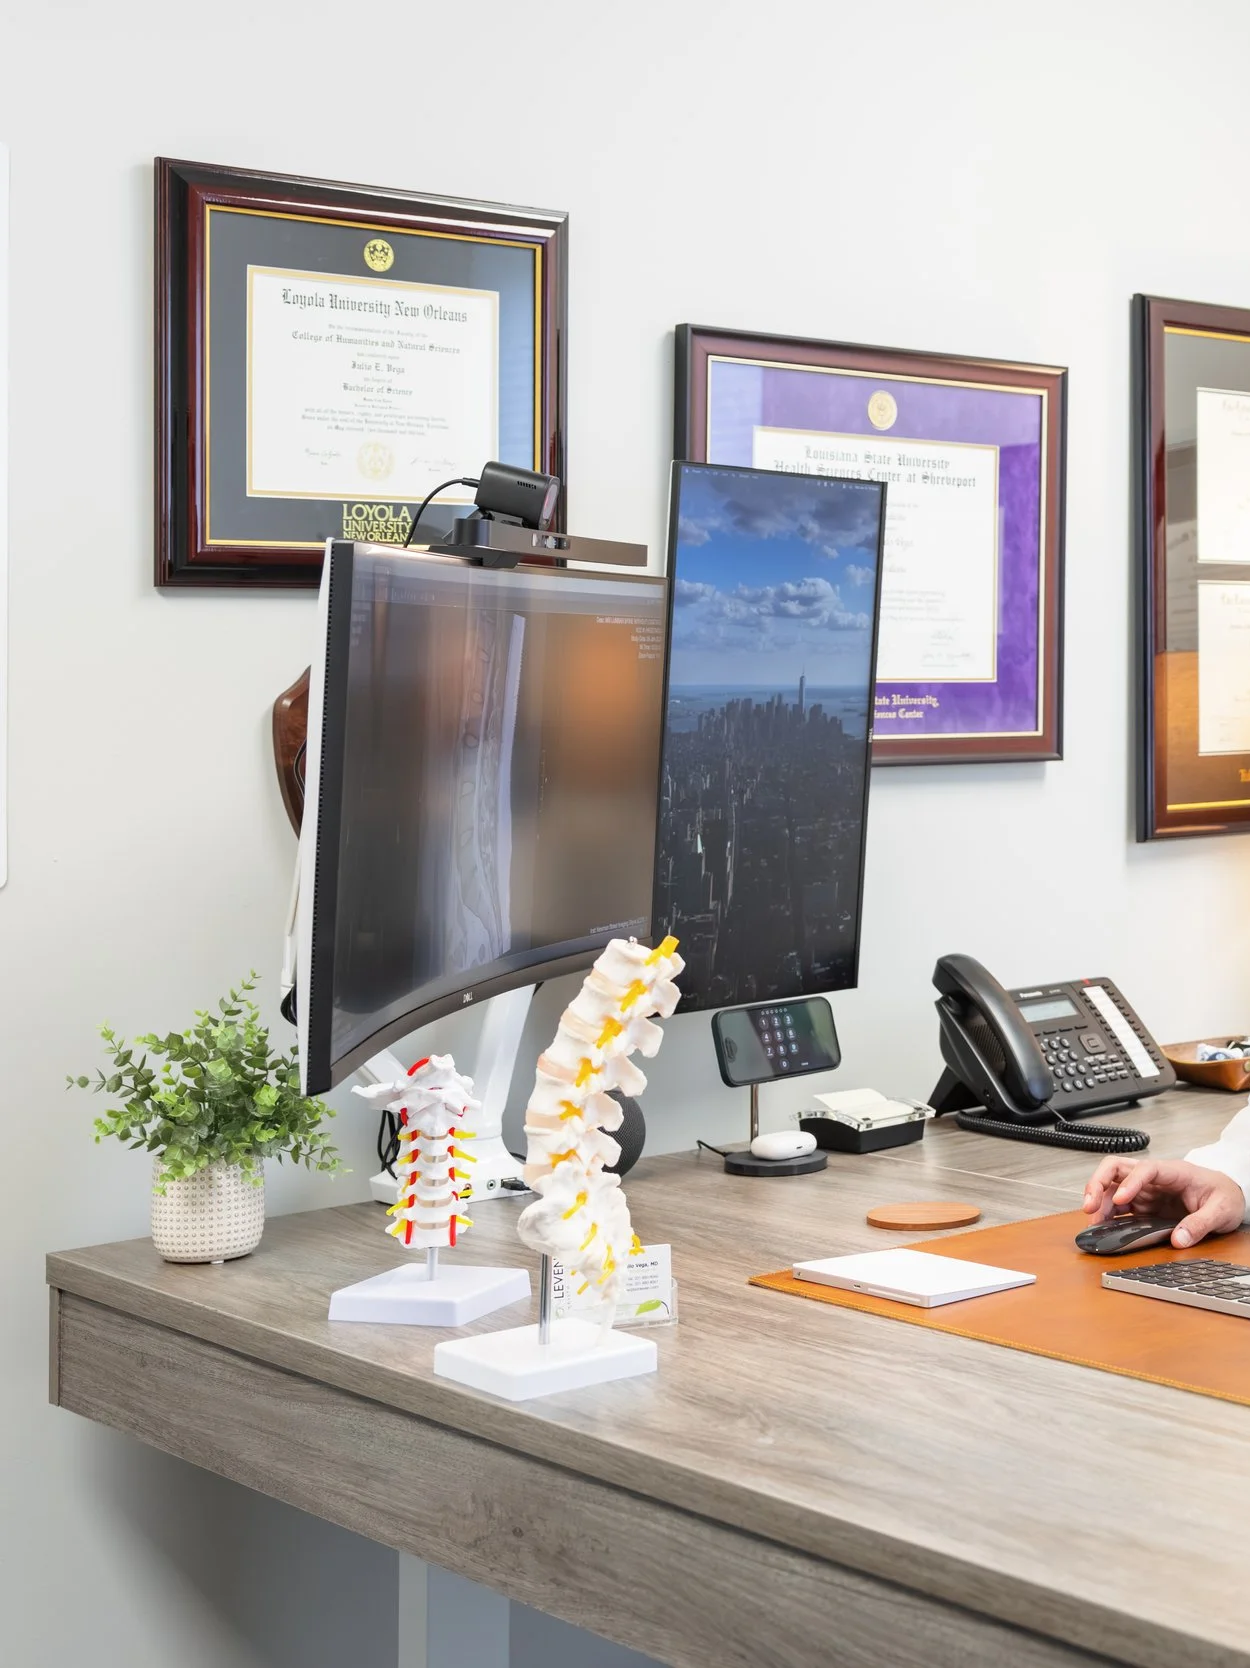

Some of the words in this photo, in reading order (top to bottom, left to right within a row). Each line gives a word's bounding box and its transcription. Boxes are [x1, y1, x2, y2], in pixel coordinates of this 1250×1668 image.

[282, 288, 325, 310] Loyola
[329, 293, 391, 318] University
[395, 300, 420, 317] New
[423, 304, 468, 323] Orleans
[292, 330, 323, 343] College
[325, 333, 334, 343] of
[336, 334, 379, 347] Humanities
[381, 338, 395, 349] and
[397, 340, 426, 352] Natural
[428, 343, 461, 354] Sciences
[343, 382, 374, 393] Bachelor
[804, 445, 859, 464] Louisiana
[863, 450, 892, 465] State
[897, 453, 950, 470] University
[774, 459, 811, 475] Health
[867, 467, 901, 483] Center
[906, 471, 917, 484] at
[921, 472, 976, 489] Shreveport
[342, 503, 412, 522] LOYOLA
[342, 520, 413, 533] UNIVERSITY
[343, 531, 367, 540] NEW
[367, 532, 413, 543] ORLEAN
[875, 695, 890, 705] tate
[891, 694, 940, 708] University,
[898, 708, 924, 719] Center
